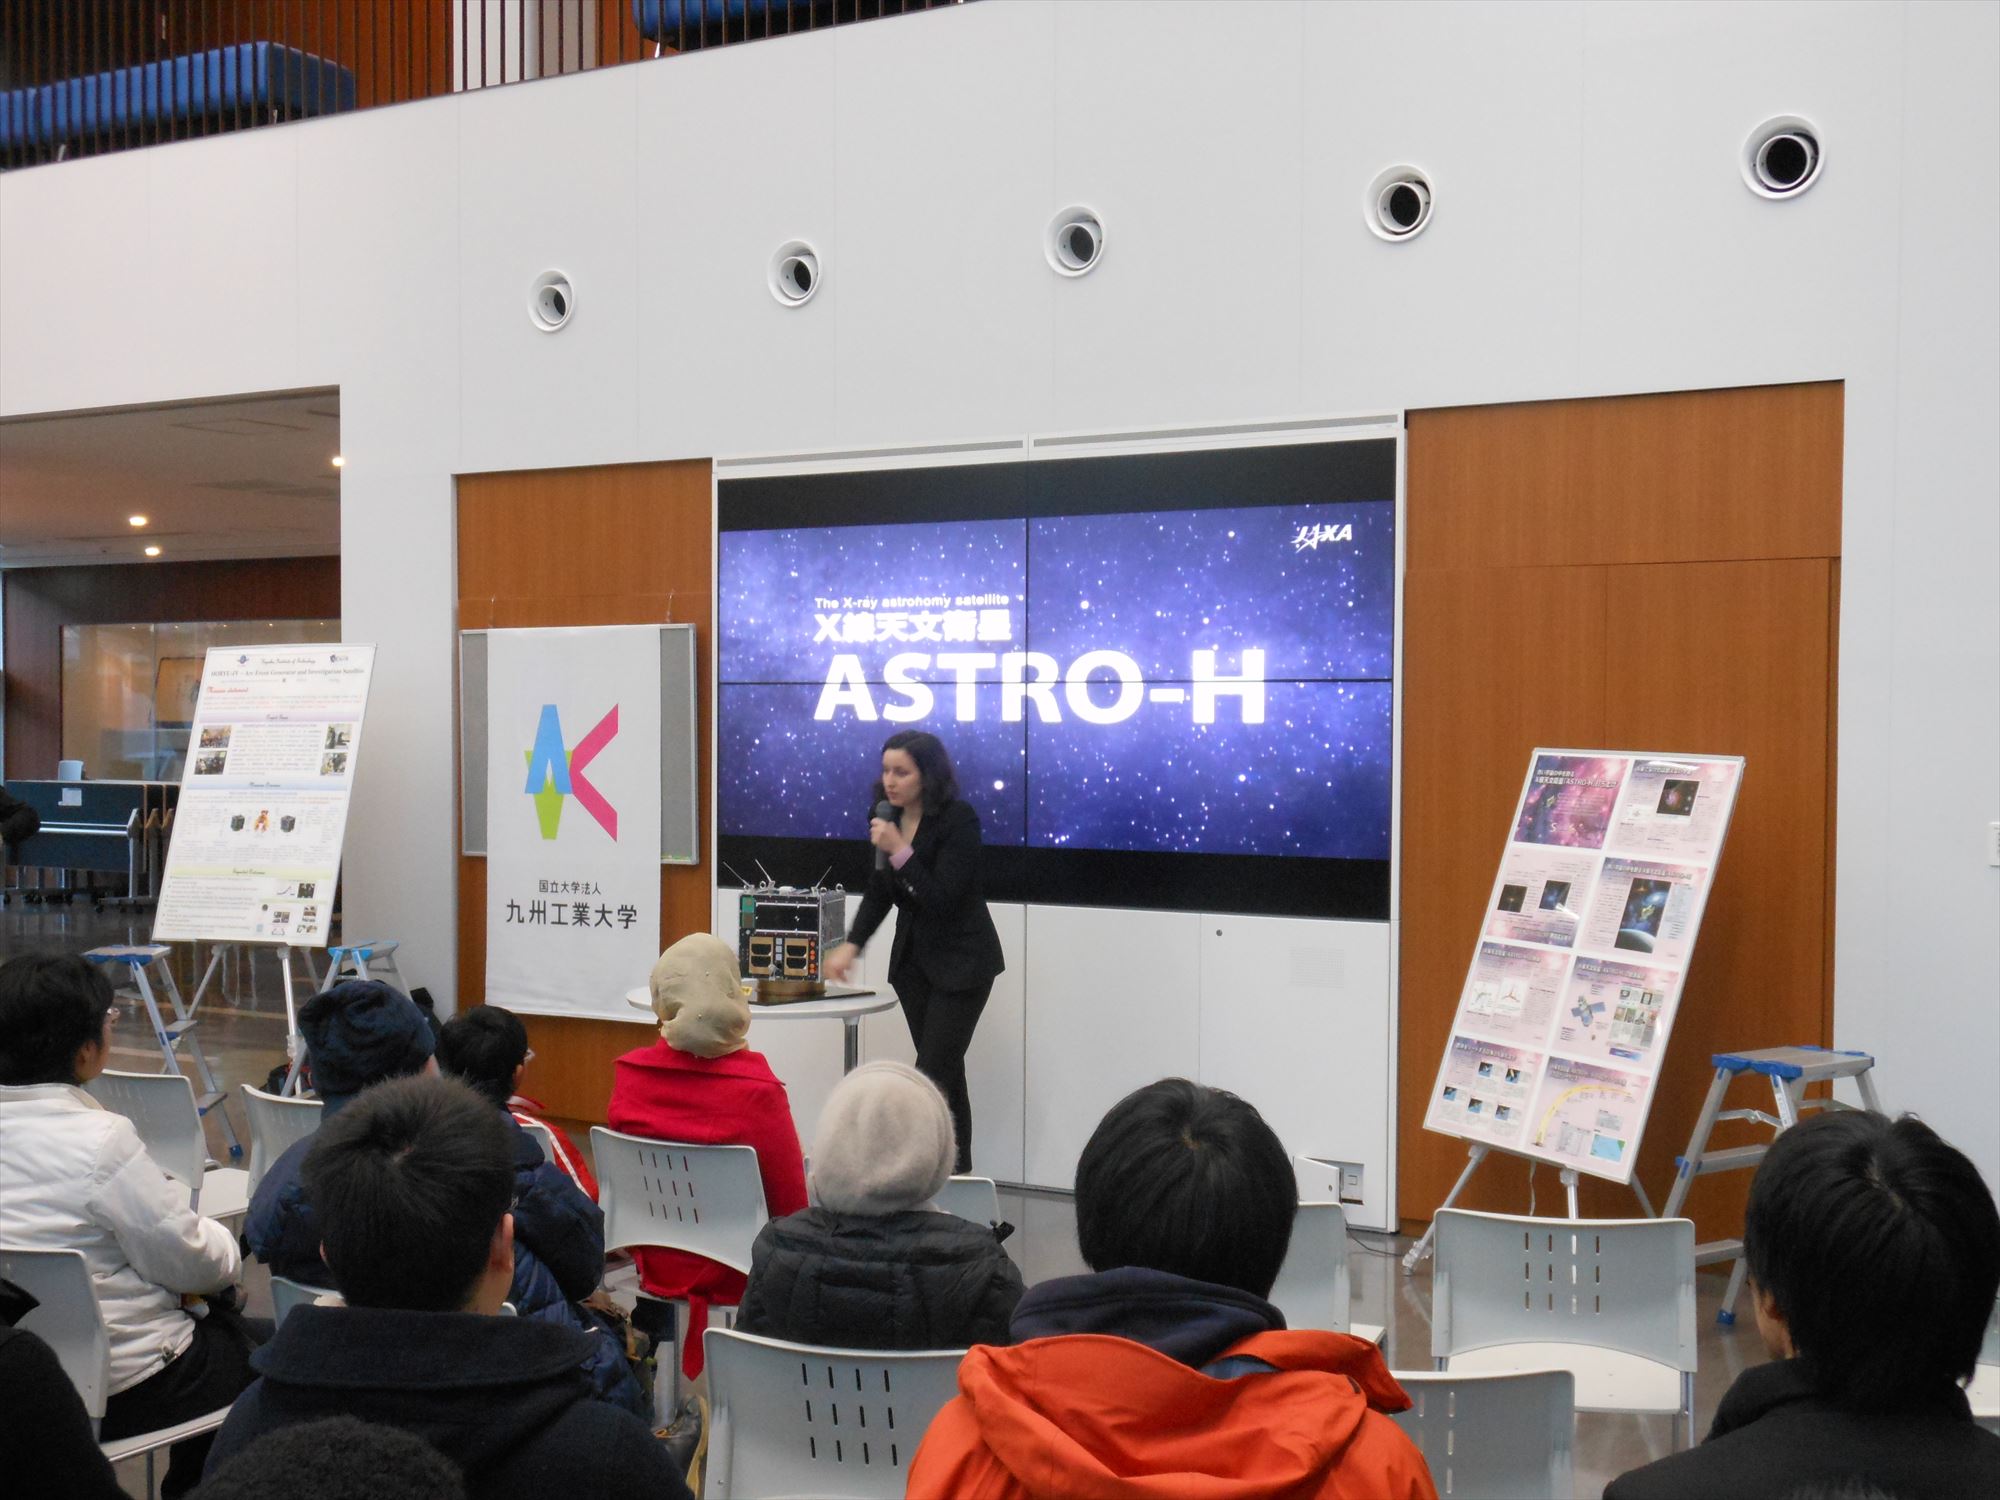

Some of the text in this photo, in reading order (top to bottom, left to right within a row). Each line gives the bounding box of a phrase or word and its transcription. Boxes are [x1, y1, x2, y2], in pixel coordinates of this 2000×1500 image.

[1290, 523, 1352, 553] JAXA
[815, 593, 1009, 611] The X-ray astronomy satellite
[814, 648, 1266, 725] ASTRO-H
[539, 879, 601, 895] 国立大学法人
[506, 898, 637, 929] 九州工業大学
